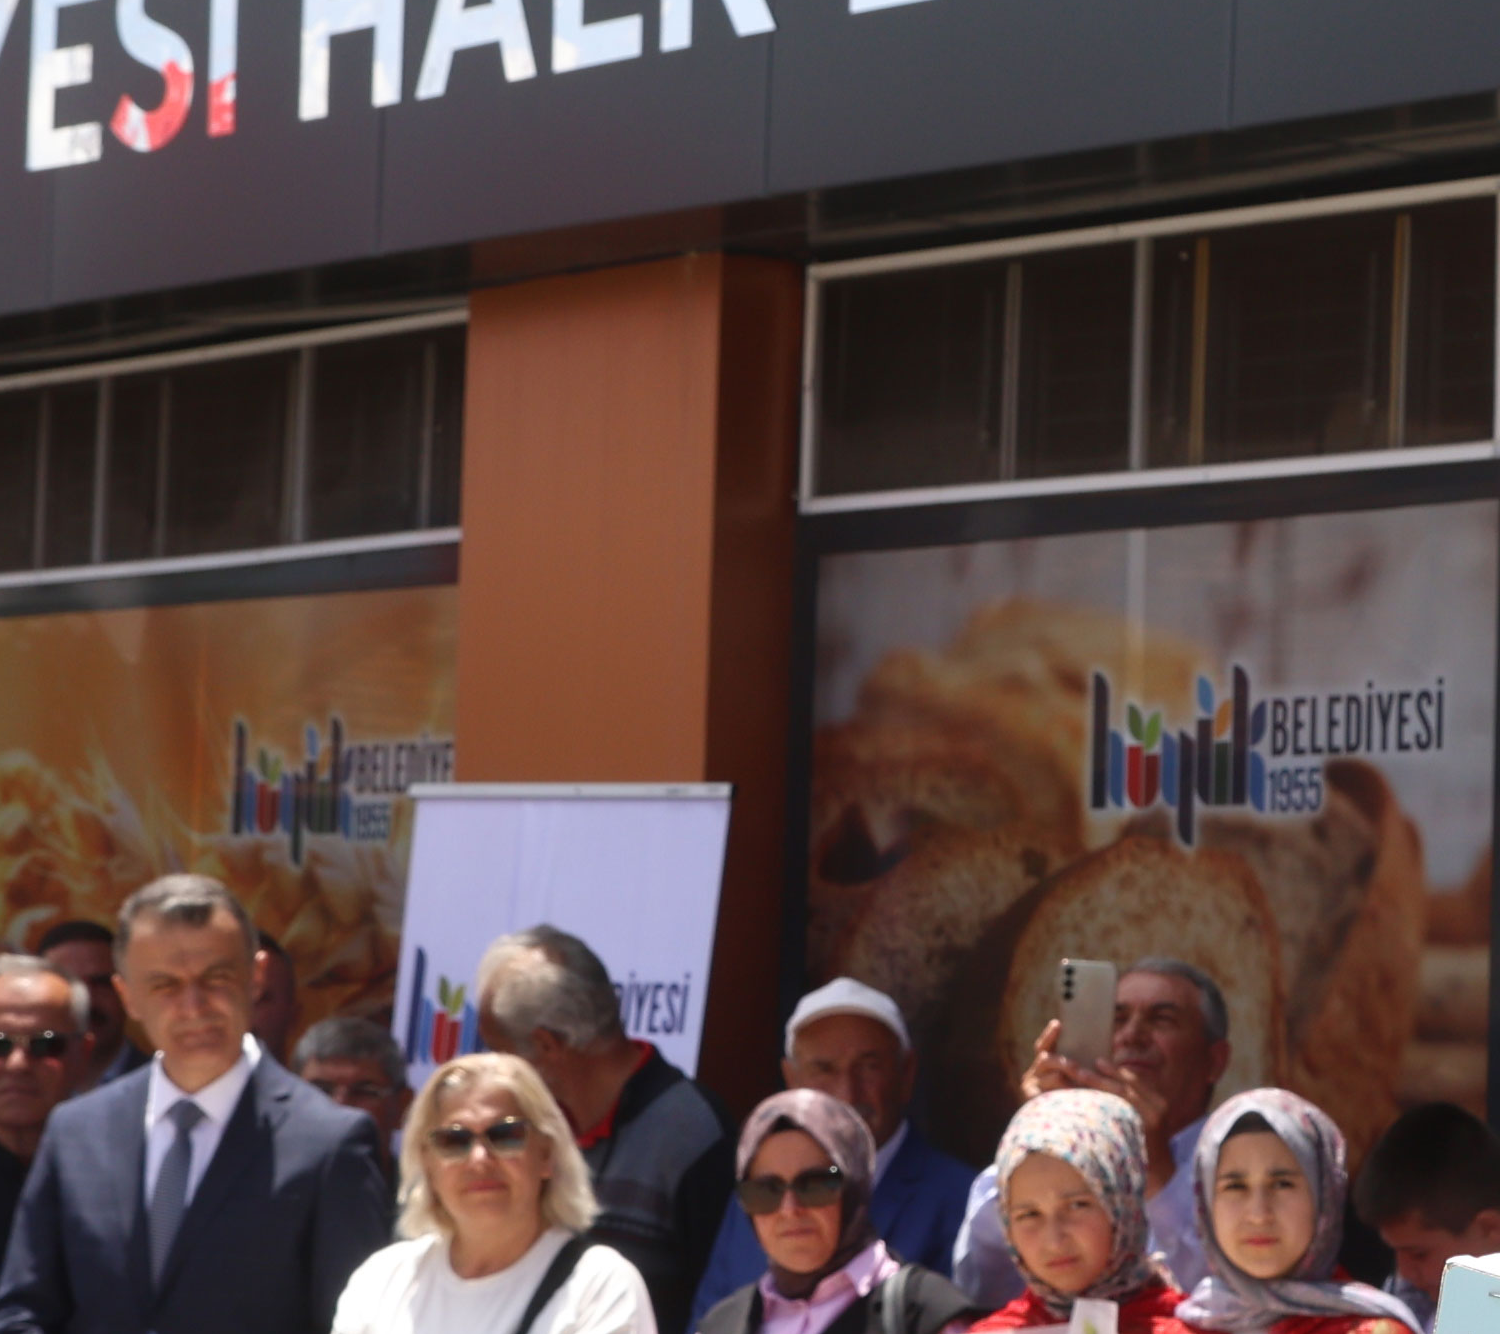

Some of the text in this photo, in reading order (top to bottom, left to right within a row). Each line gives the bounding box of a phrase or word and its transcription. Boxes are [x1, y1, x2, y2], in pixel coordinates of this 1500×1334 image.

[1270, 677, 1444, 756] BELEDİYESİ
[354, 732, 454, 793] BELEDİYE
[1268, 766, 1323, 814] 1955
